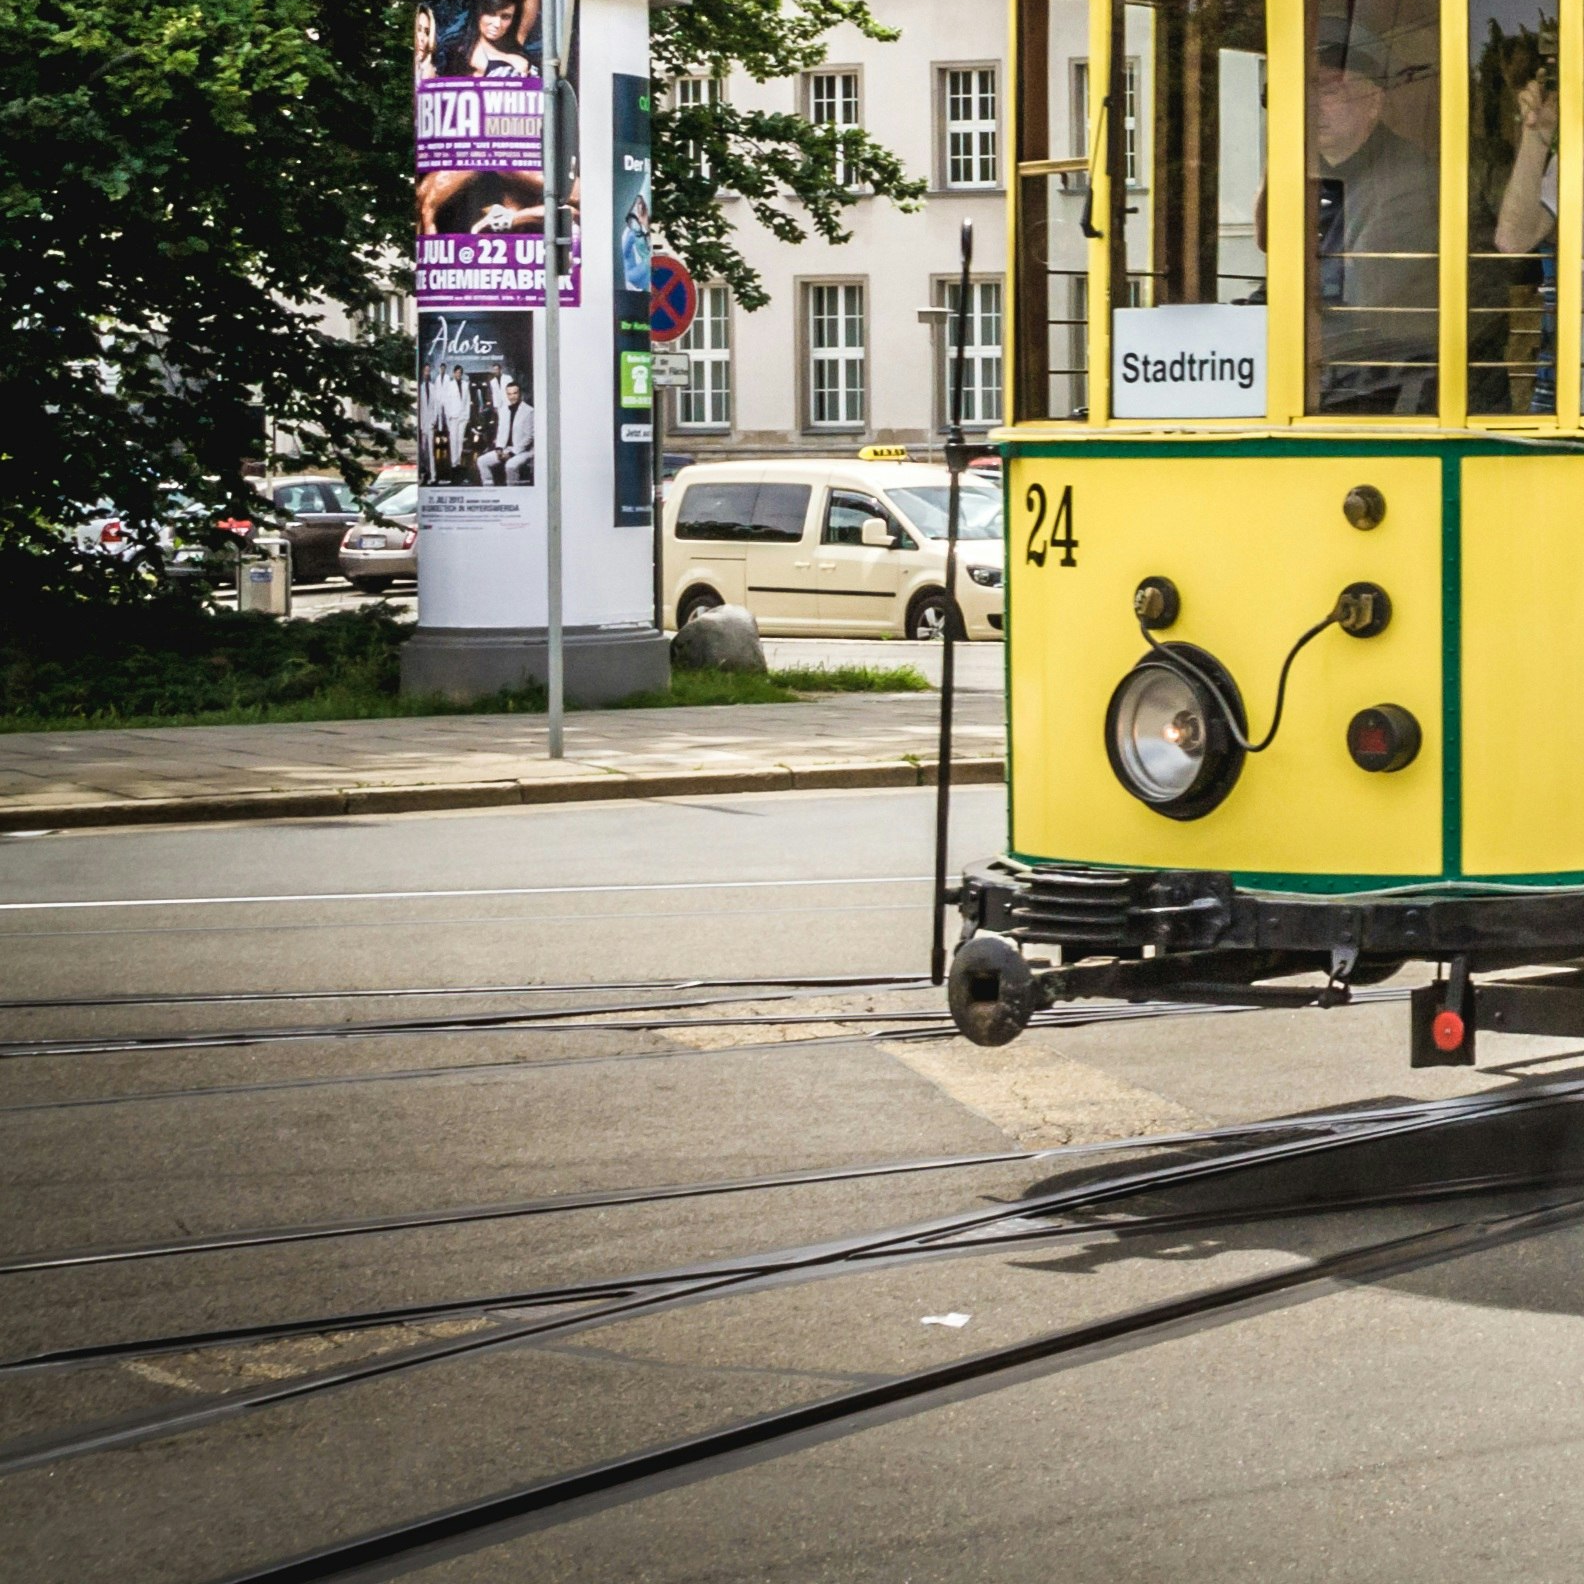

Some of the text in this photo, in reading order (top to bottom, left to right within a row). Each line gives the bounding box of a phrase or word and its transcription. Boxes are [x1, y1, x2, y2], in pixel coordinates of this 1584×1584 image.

[417, 90, 480, 138] IBIZA
[624, 155, 643, 171] Der
[423, 240, 454, 264] JULI
[459, 247, 474, 264] @
[477, 239, 507, 264] 22
[429, 269, 574, 290] CHEMIEFABRK
[428, 316, 498, 360] Adoro
[1122, 351, 1254, 389] Stadtring
[1026, 483, 1079, 567] 24
